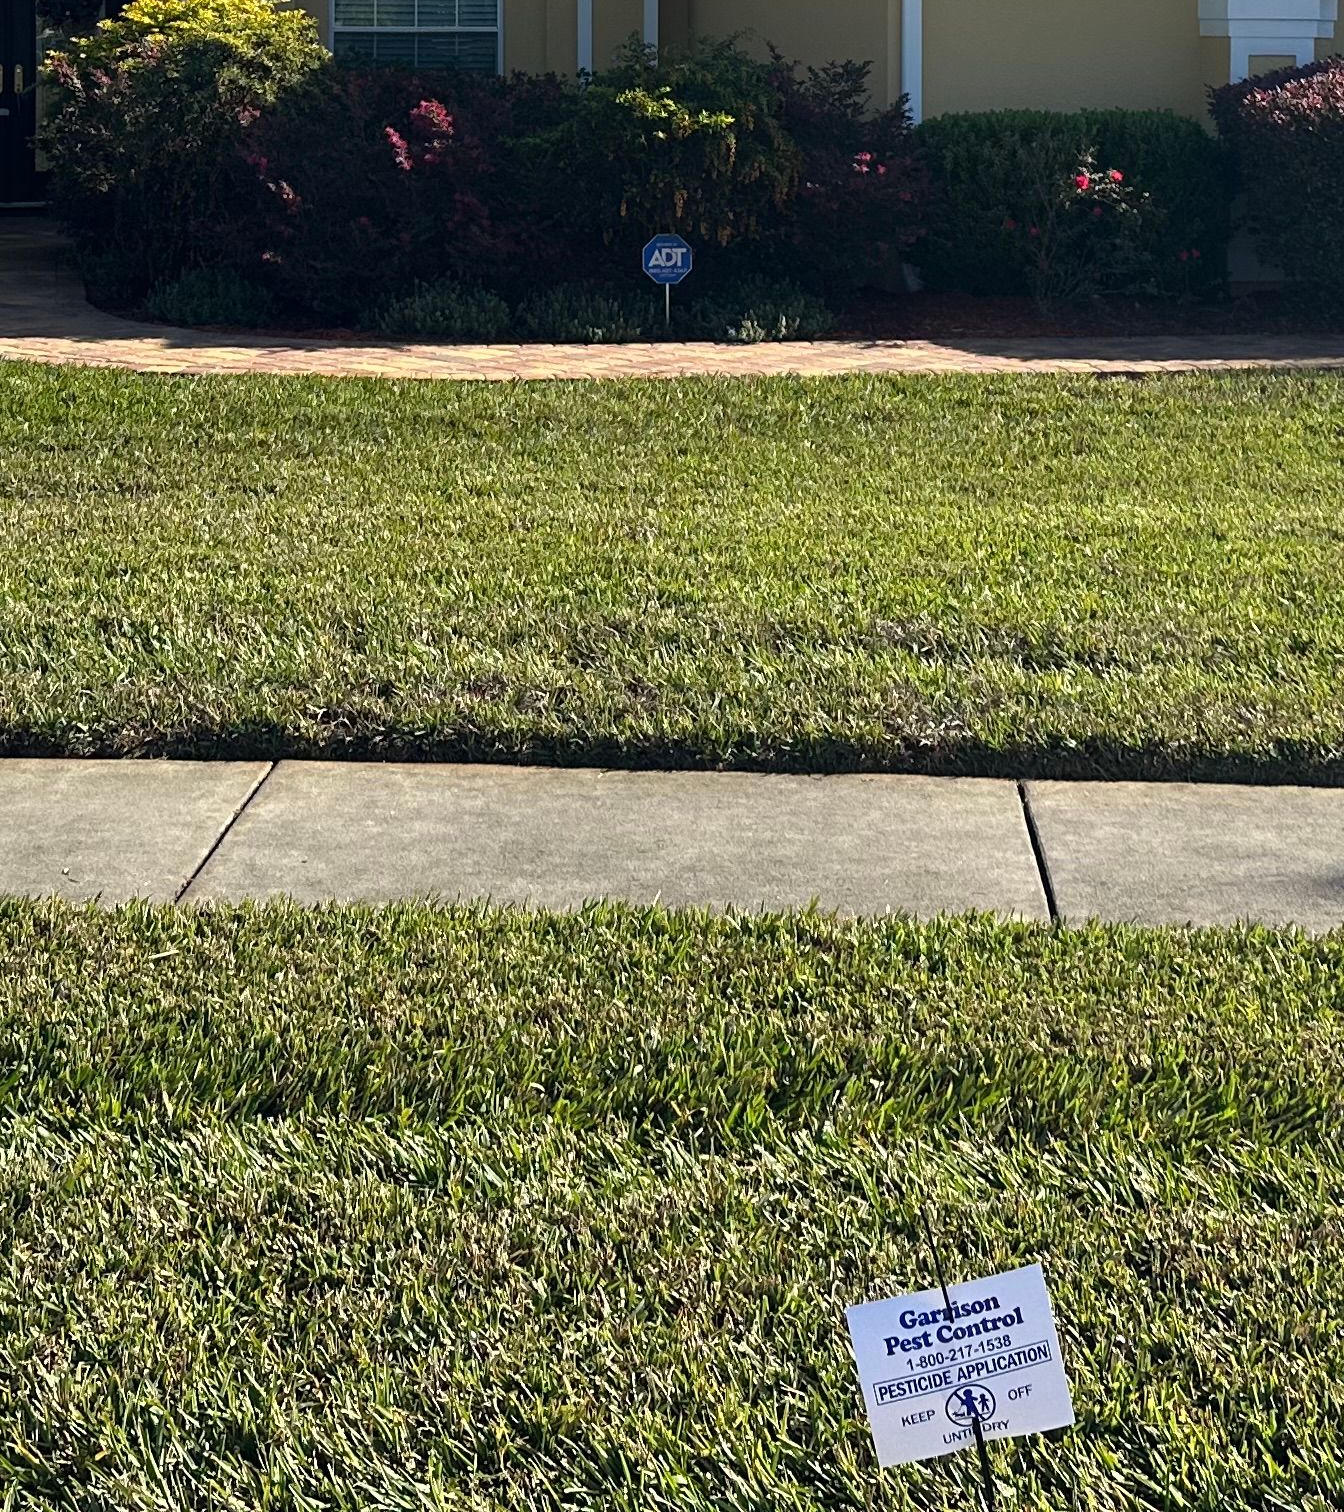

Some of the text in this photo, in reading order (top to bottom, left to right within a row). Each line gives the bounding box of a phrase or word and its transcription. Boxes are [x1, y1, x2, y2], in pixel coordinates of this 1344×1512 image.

[648, 248, 687, 267] ADT
[884, 1307, 1024, 1356] Pest Control
[879, 1344, 1048, 1401] PESTICIDE APPLICATION
[906, 1334, 1012, 1371] 1-800-217-1538
[901, 1384, 1033, 1427] KEEP OFF
[942, 1419, 1009, 1445] UNTI DRY
